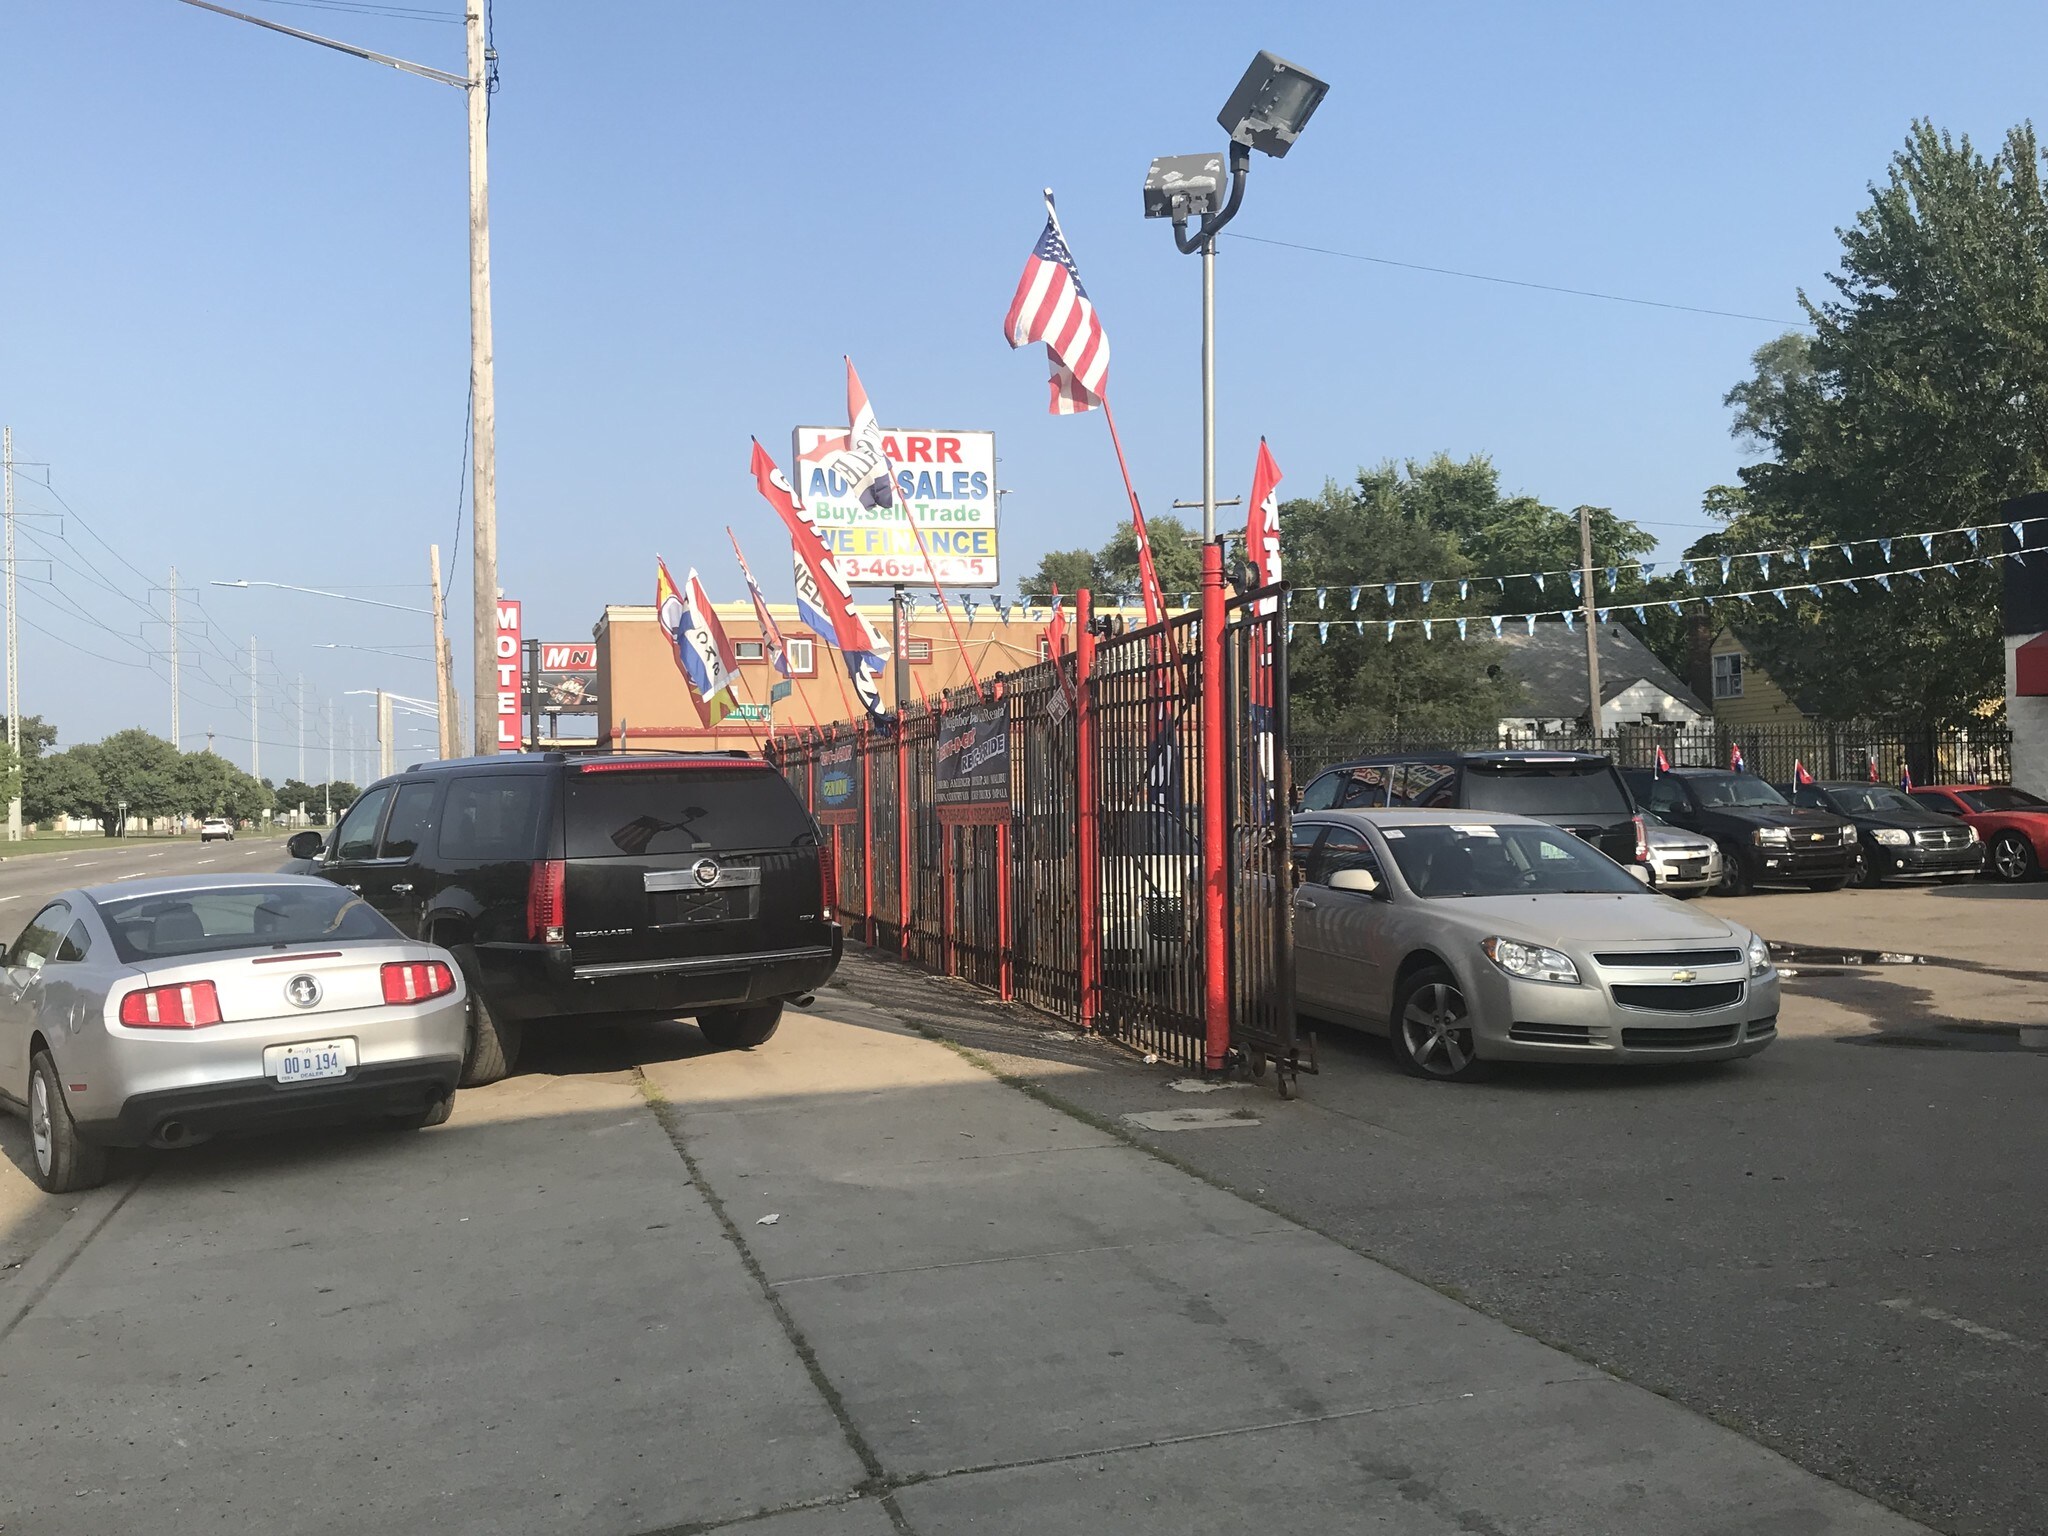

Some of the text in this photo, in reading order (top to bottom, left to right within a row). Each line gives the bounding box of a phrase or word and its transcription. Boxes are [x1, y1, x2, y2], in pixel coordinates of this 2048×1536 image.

[809, 467, 868, 499] AU
[897, 469, 989, 500] SALES
[915, 503, 981, 522] Trade
[866, 530, 989, 554] FINANCE
[497, 607, 517, 742] MOTEL
[729, 704, 770, 722] amburg
[300, 1071, 324, 1079] DEALER
